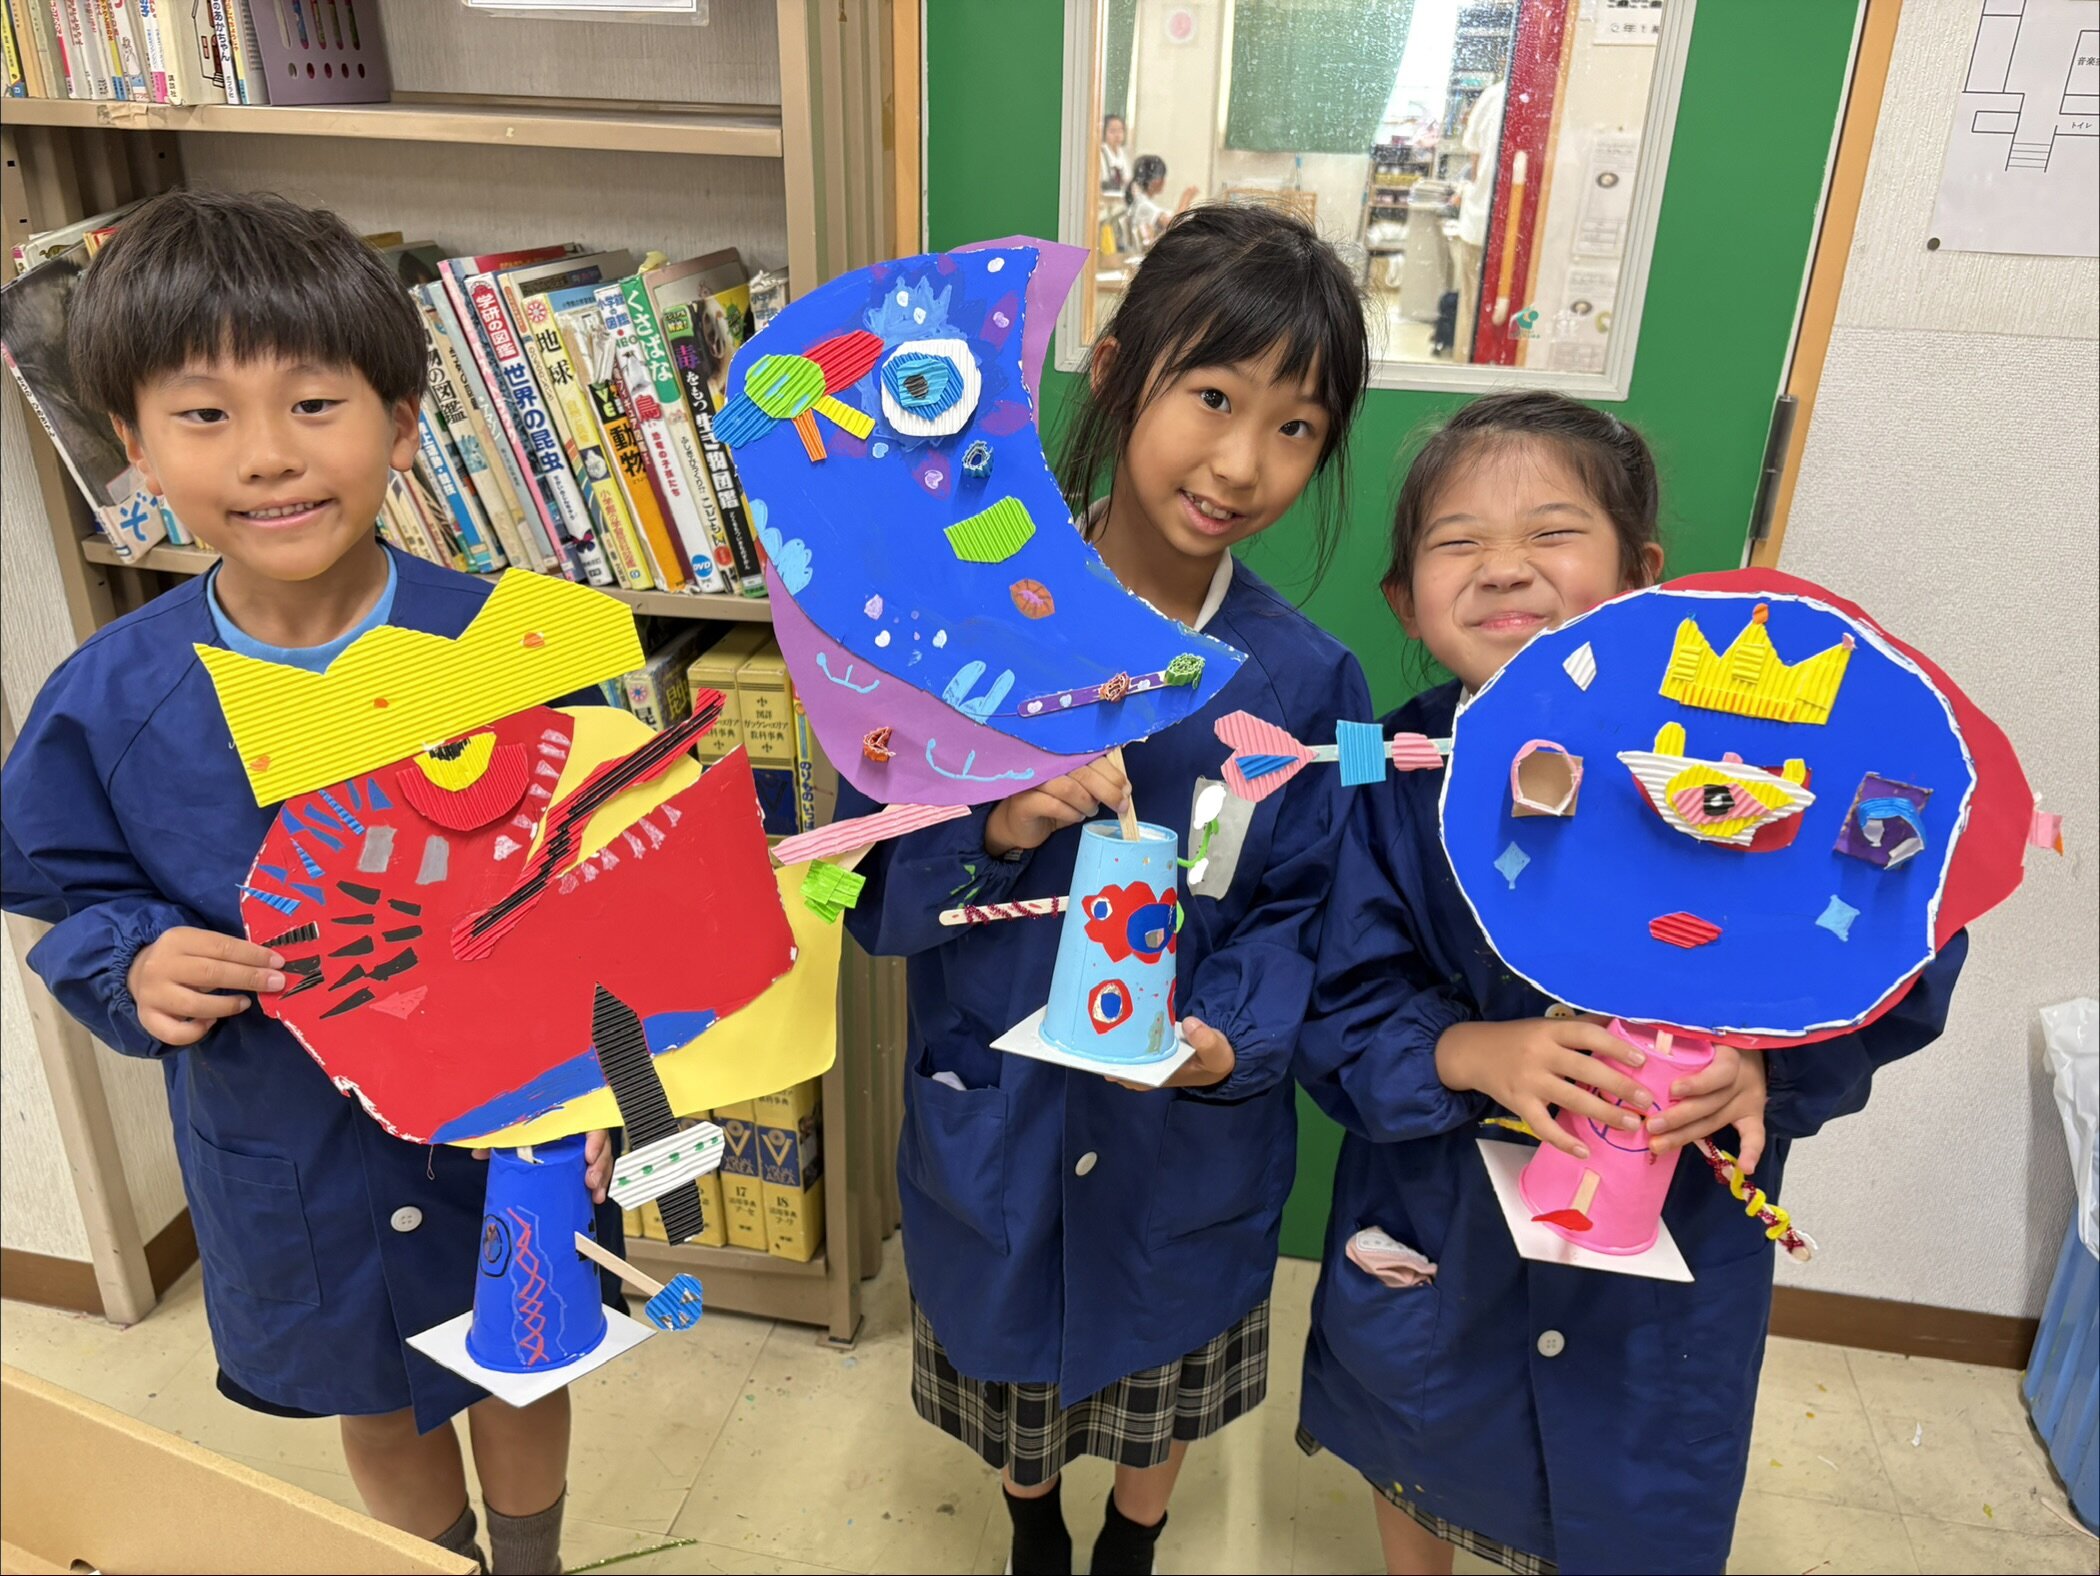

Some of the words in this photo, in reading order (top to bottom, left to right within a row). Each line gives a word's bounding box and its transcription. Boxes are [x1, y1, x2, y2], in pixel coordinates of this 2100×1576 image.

[212, 0, 231, 62] のあかちゃん
[2071, 121, 2093, 129] トイレ
[475, 292, 517, 359] 学研の図鑑
[627, 289, 674, 382] くさばな
[426, 329, 467, 424] 物の図鑑
[535, 328, 574, 385] 地球
[503, 362, 565, 472] 世界の昆虫
[610, 422, 647, 478] 動物
[692, 561, 711, 571] DVD
[735, 1186, 747, 1198] 17
[776, 1195, 789, 1208] 18
